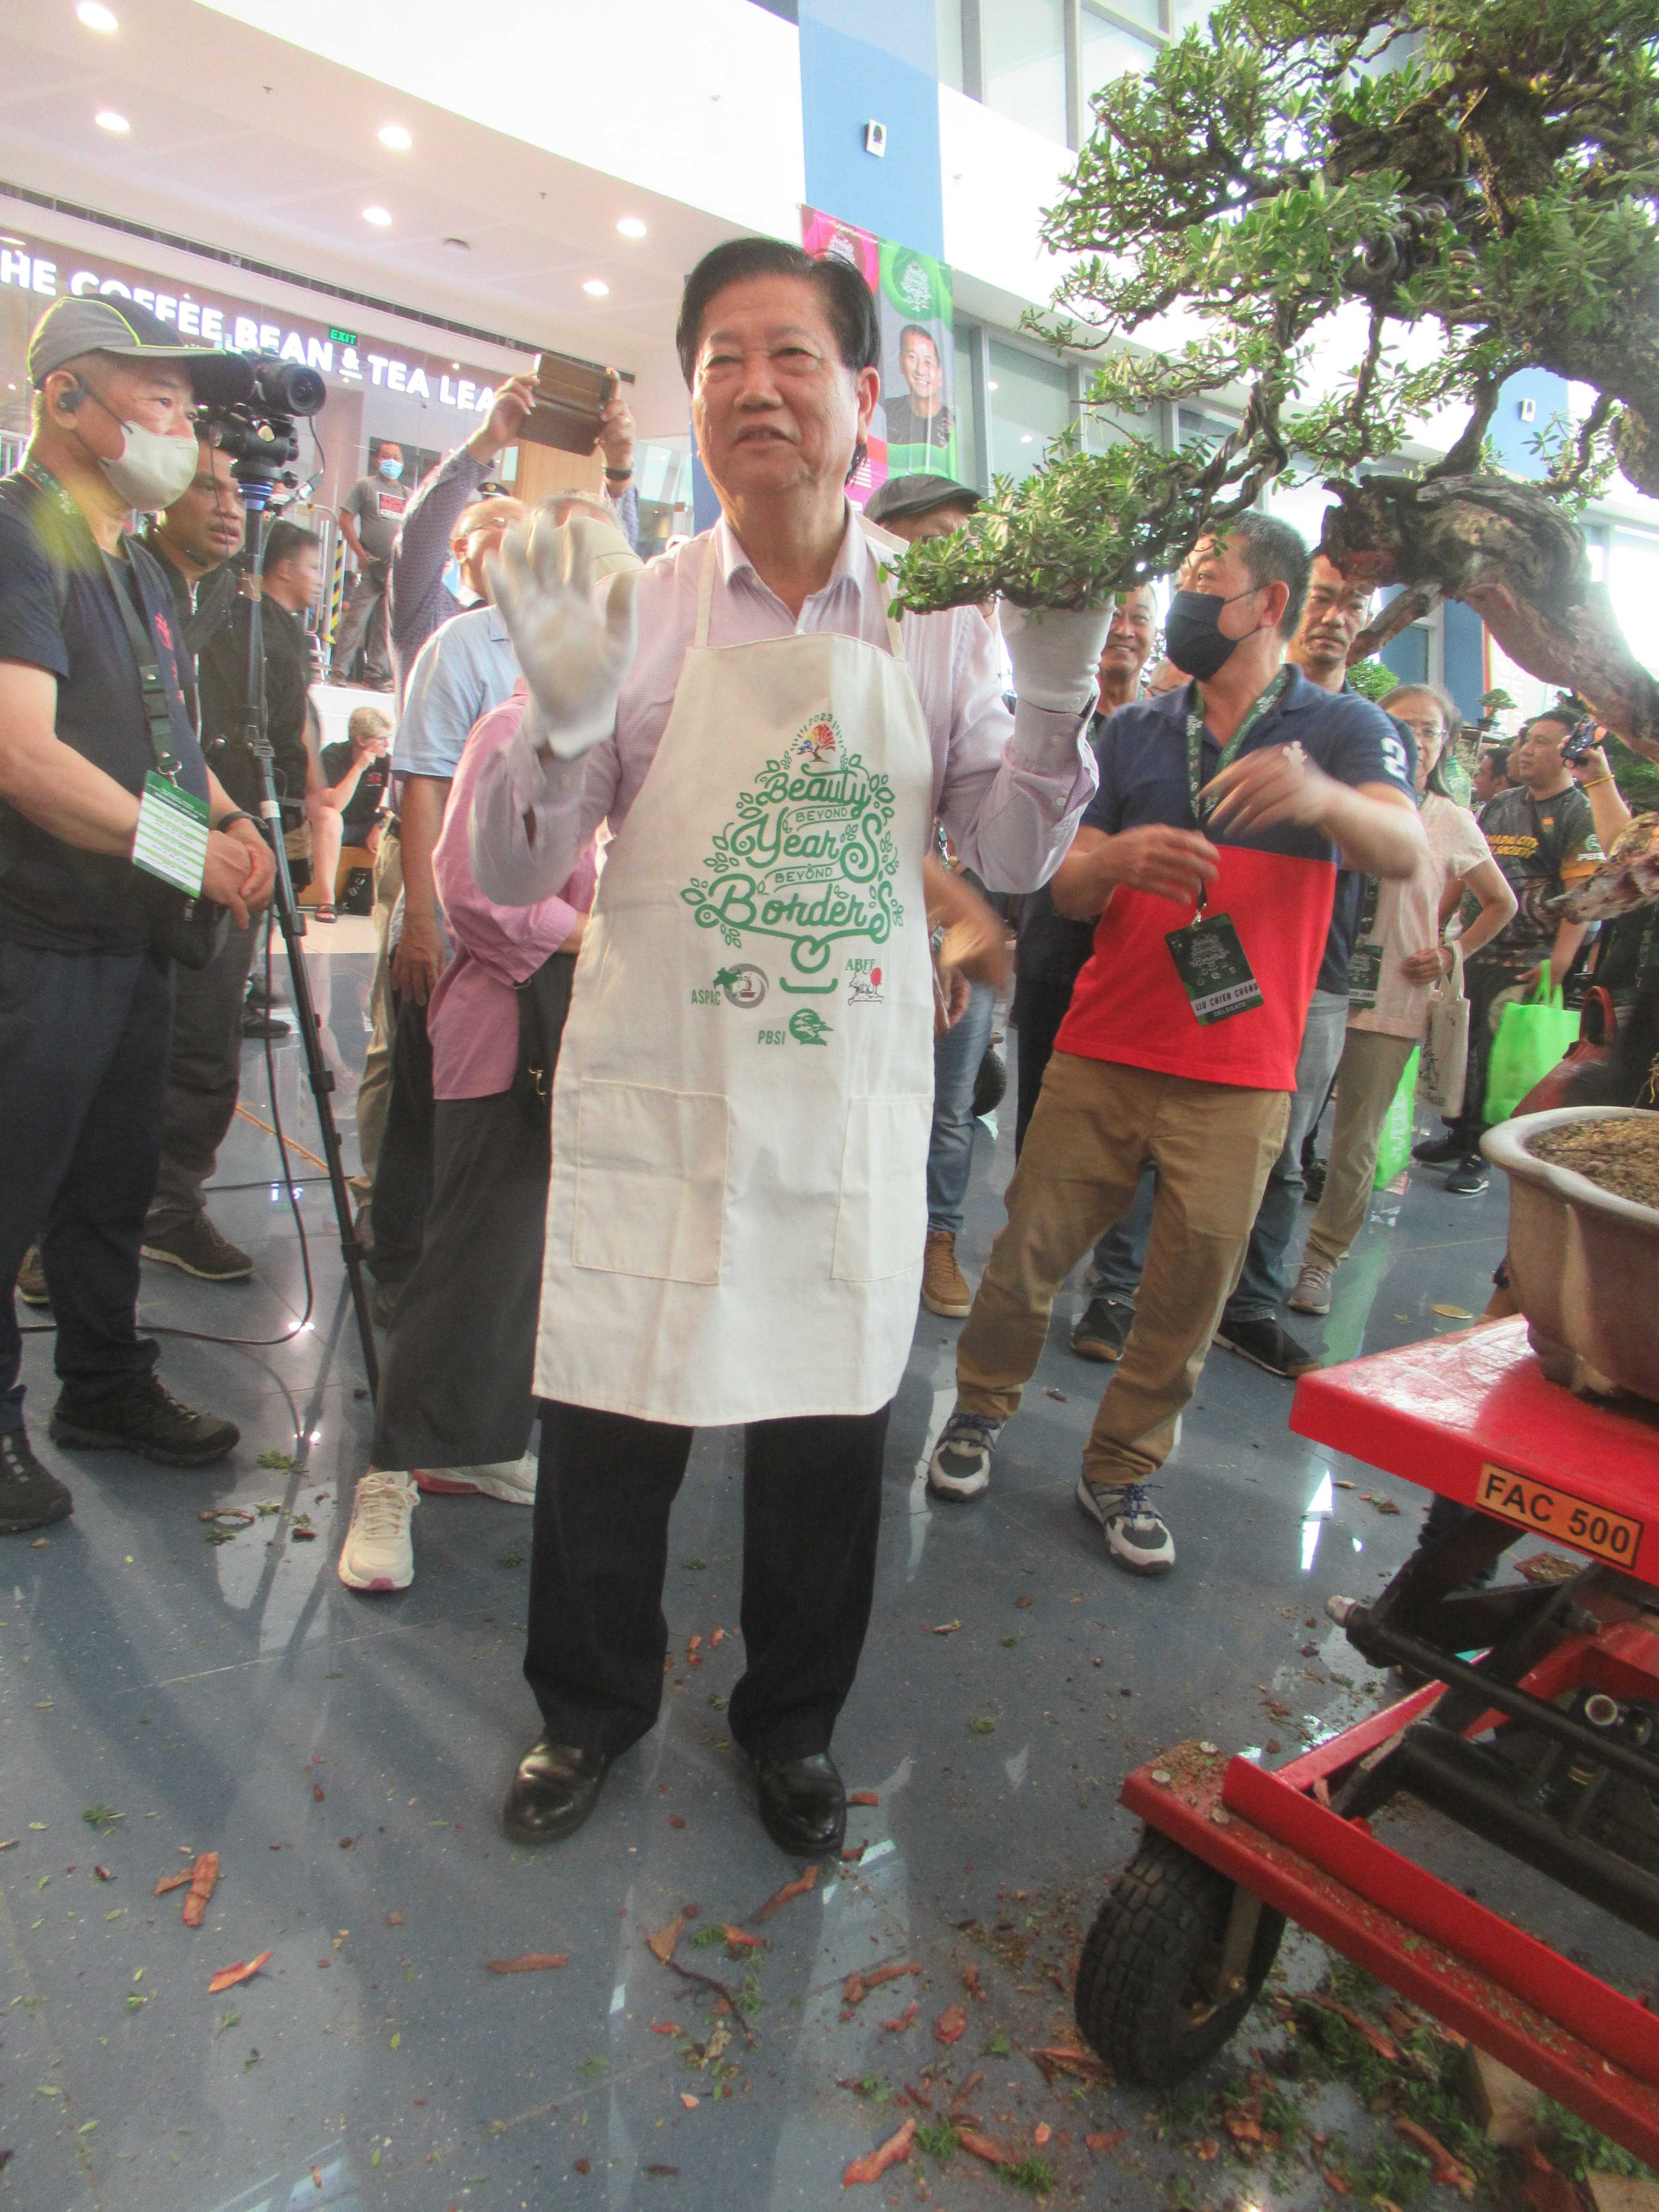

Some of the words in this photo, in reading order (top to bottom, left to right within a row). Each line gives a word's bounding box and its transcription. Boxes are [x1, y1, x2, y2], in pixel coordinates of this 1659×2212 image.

[0, 250, 56, 296] HE
[235, 317, 333, 371] BEAN
[340, 347, 361, 375] &
[367, 355, 430, 398] TEA
[439, 375, 496, 412] LEA
[330, 329, 356, 345] EXIT
[808, 712, 833, 726] 2023
[756, 764, 871, 819] Beauty
[796, 807, 848, 822] BEYOND
[775, 867, 833, 884] BEYOND
[845, 959, 876, 971] ABFF
[691, 989, 720, 1005] ASPAC
[1195, 1001, 1207, 1011] LIU
[1210, 992, 1231, 1006] CHIEN
[1213, 1002, 1246, 1017] DELEGATE
[757, 1030, 786, 1045] PBSI
[1484, 1473, 1554, 1522] FAC
[1568, 1507, 1630, 1554] 500
